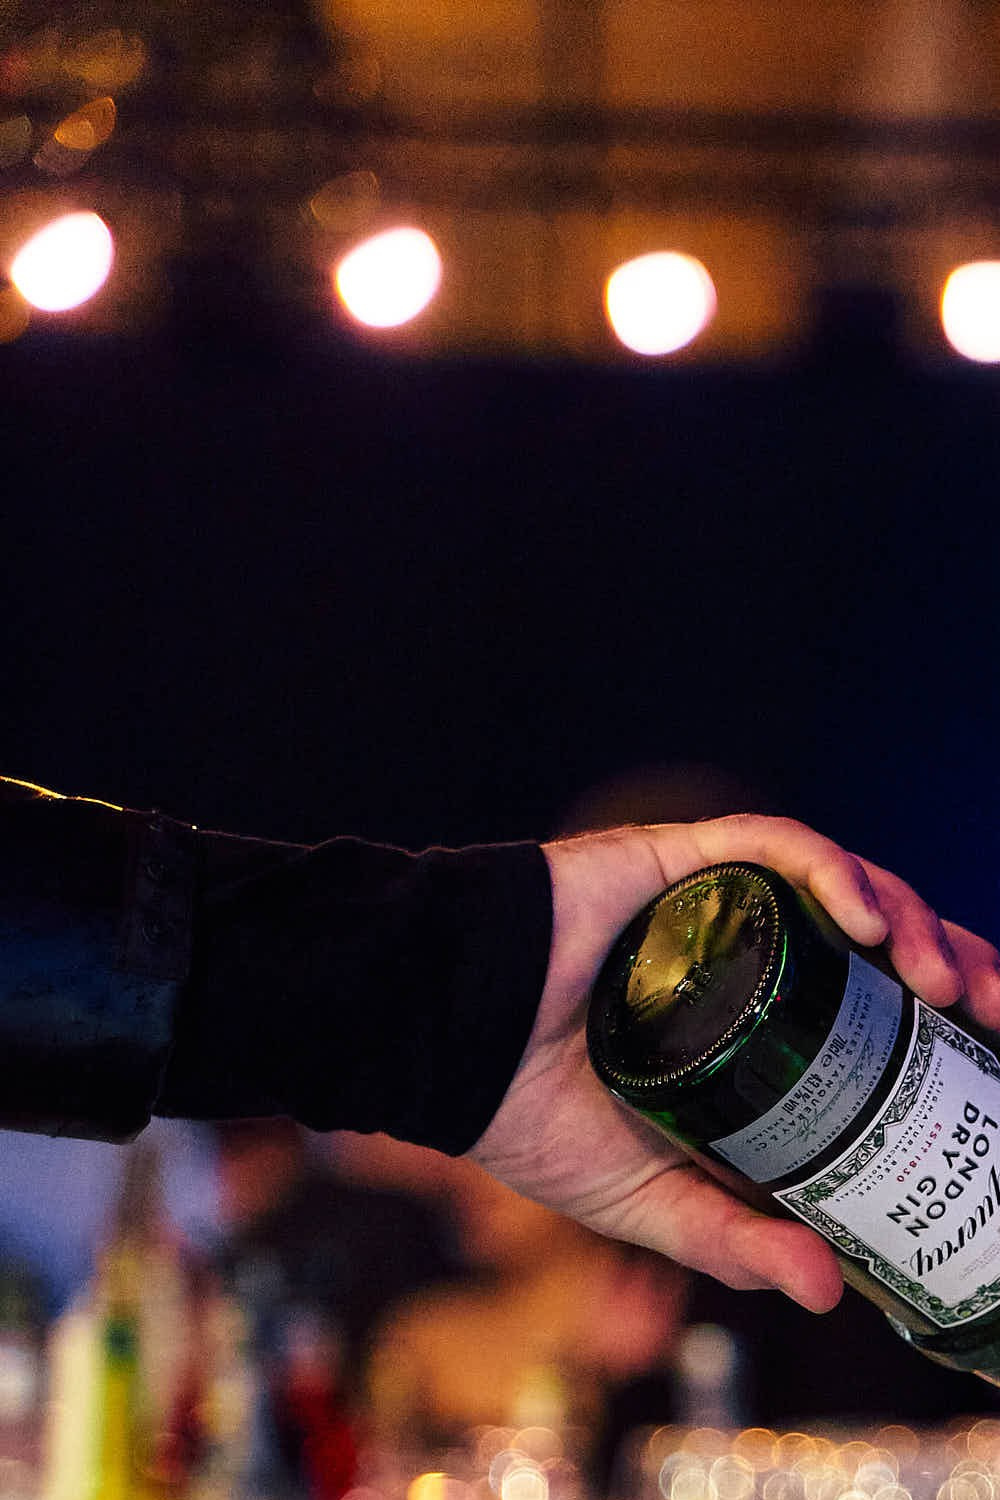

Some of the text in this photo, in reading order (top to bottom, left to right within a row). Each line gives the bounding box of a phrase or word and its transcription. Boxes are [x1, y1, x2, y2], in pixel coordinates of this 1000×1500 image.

[826, 1032, 847, 1058] 70cl
[844, 993, 873, 1056] CHARLES
[781, 1061, 845, 1134] TANQUERAY
[857, 1080, 944, 1197] SIGNATURE RECIPE
[885, 1100, 981, 1225] DRY GIN
[895, 1154, 921, 1183] 1830
[905, 1114, 999, 1238] LONDON
